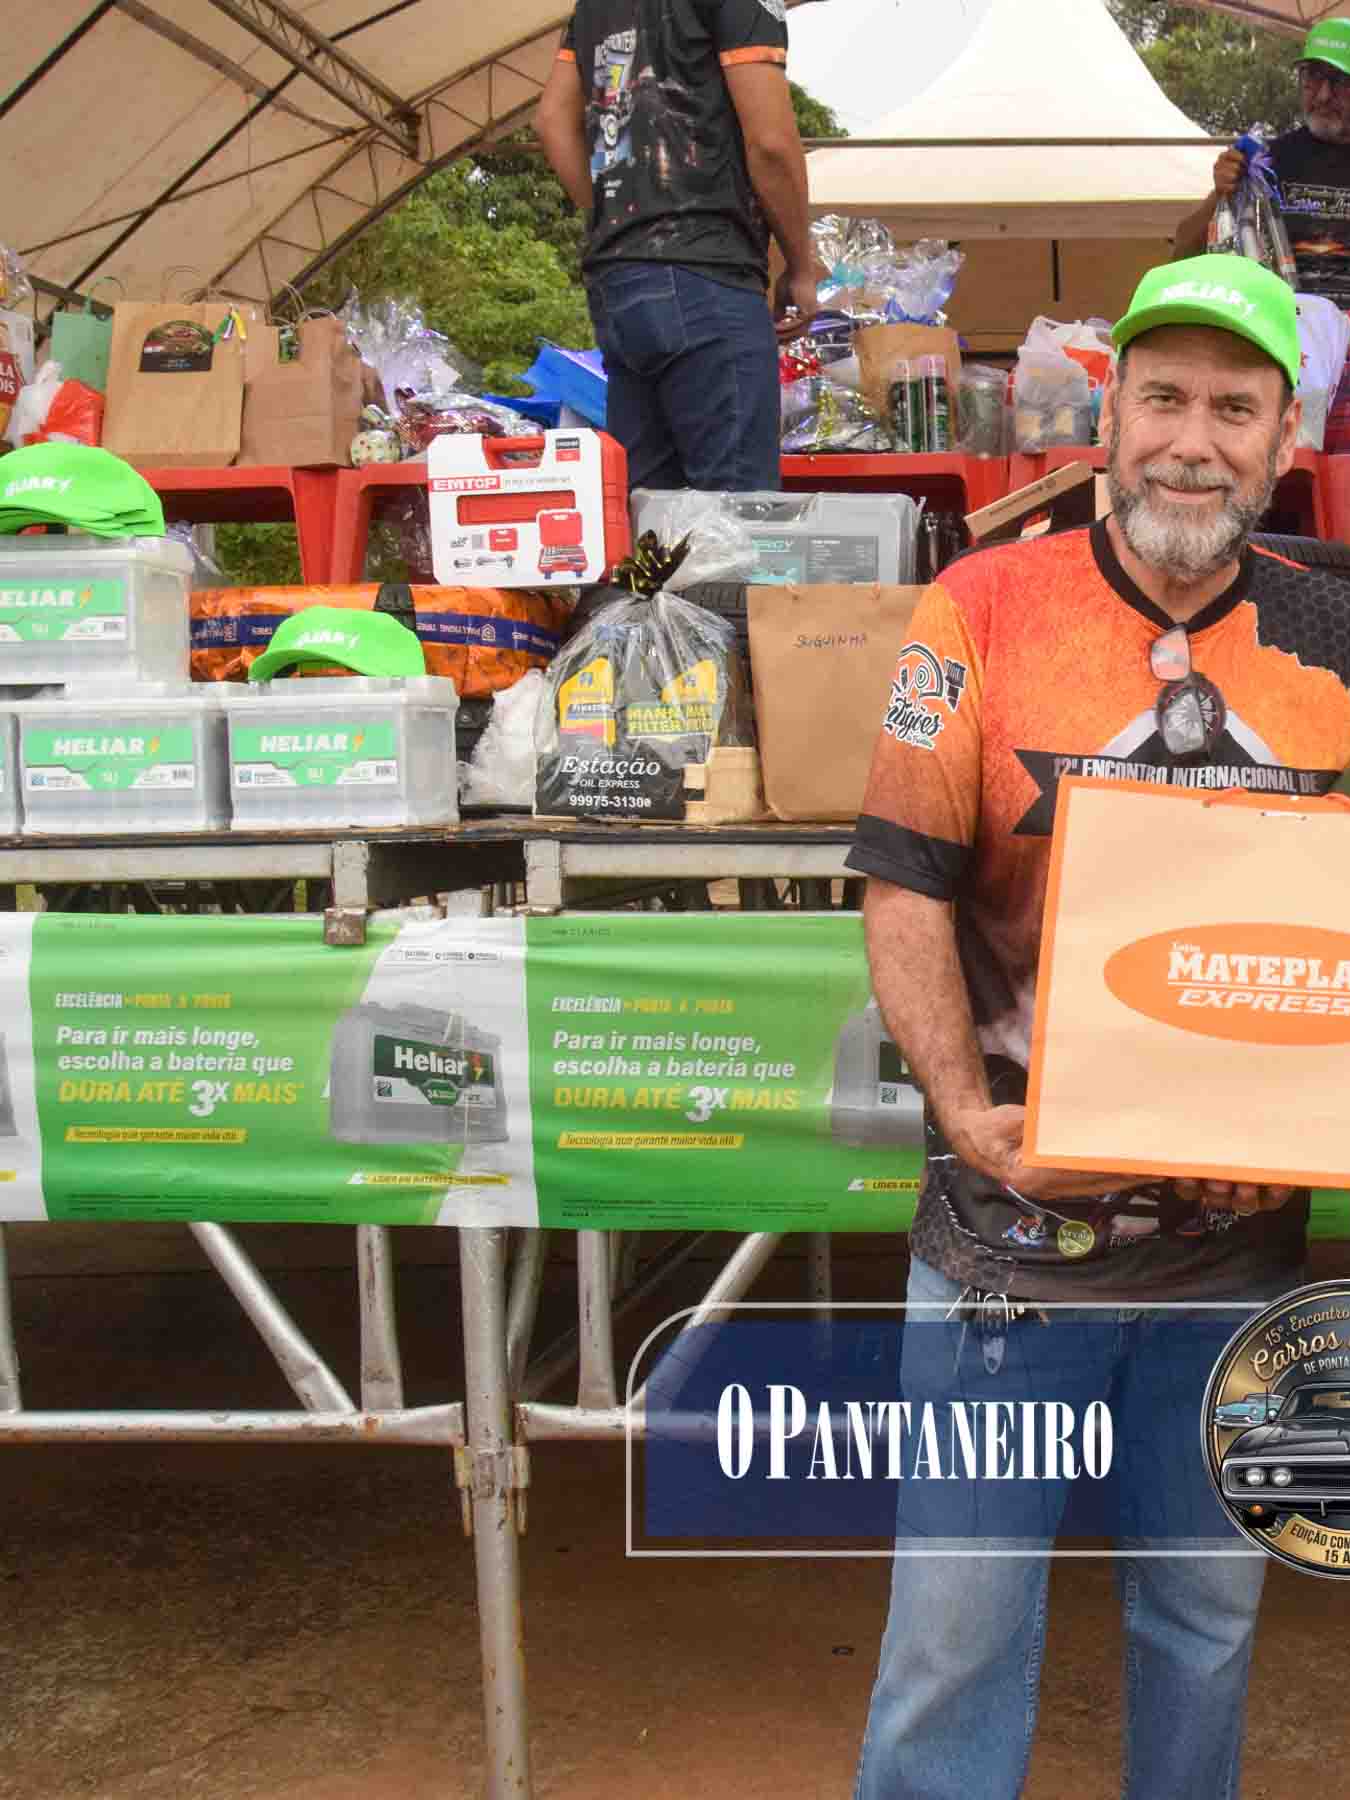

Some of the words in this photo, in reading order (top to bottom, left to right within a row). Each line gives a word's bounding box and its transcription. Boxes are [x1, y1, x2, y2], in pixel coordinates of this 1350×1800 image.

[432, 477, 497, 491] EMTOP
[0, 590, 76, 608] ELIAR
[52, 736, 145, 755] HELIAR
[260, 734, 348, 752] HELIAR
[561, 755, 660, 778] Estação
[1082, 759, 1167, 785] ENCONTRO
[1172, 764, 1297, 793] INTERNACIONAL
[1300, 773, 1321, 793] DE
[579, 779, 595, 788] OIL
[599, 779, 640, 789] EXPRESS
[55, 1025, 107, 1045] Para
[111, 1025, 129, 1045] ir
[133, 1025, 187, 1046] mais
[191, 1026, 260, 1050] longe,
[552, 1030, 606, 1049] Para
[609, 1031, 627, 1050] ir
[631, 1032, 687, 1051] mais
[690, 1032, 761, 1056] longe,
[57, 1050, 145, 1071] escolha
[149, 1056, 163, 1071] a
[167, 1052, 247, 1072] bateria
[251, 1056, 294, 1076] que
[393, 1045, 468, 1076] Heliar
[552, 1056, 642, 1076] escolha
[647, 1061, 661, 1077] a
[666, 1056, 748, 1077] bateria
[752, 1061, 796, 1081] que
[58, 1080, 130, 1103] DURA
[136, 1076, 185, 1103] ATÉ
[554, 1087, 626, 1109] DURA
[631, 1083, 683, 1109] ATÉ
[731, 1087, 799, 1110] MAIS
